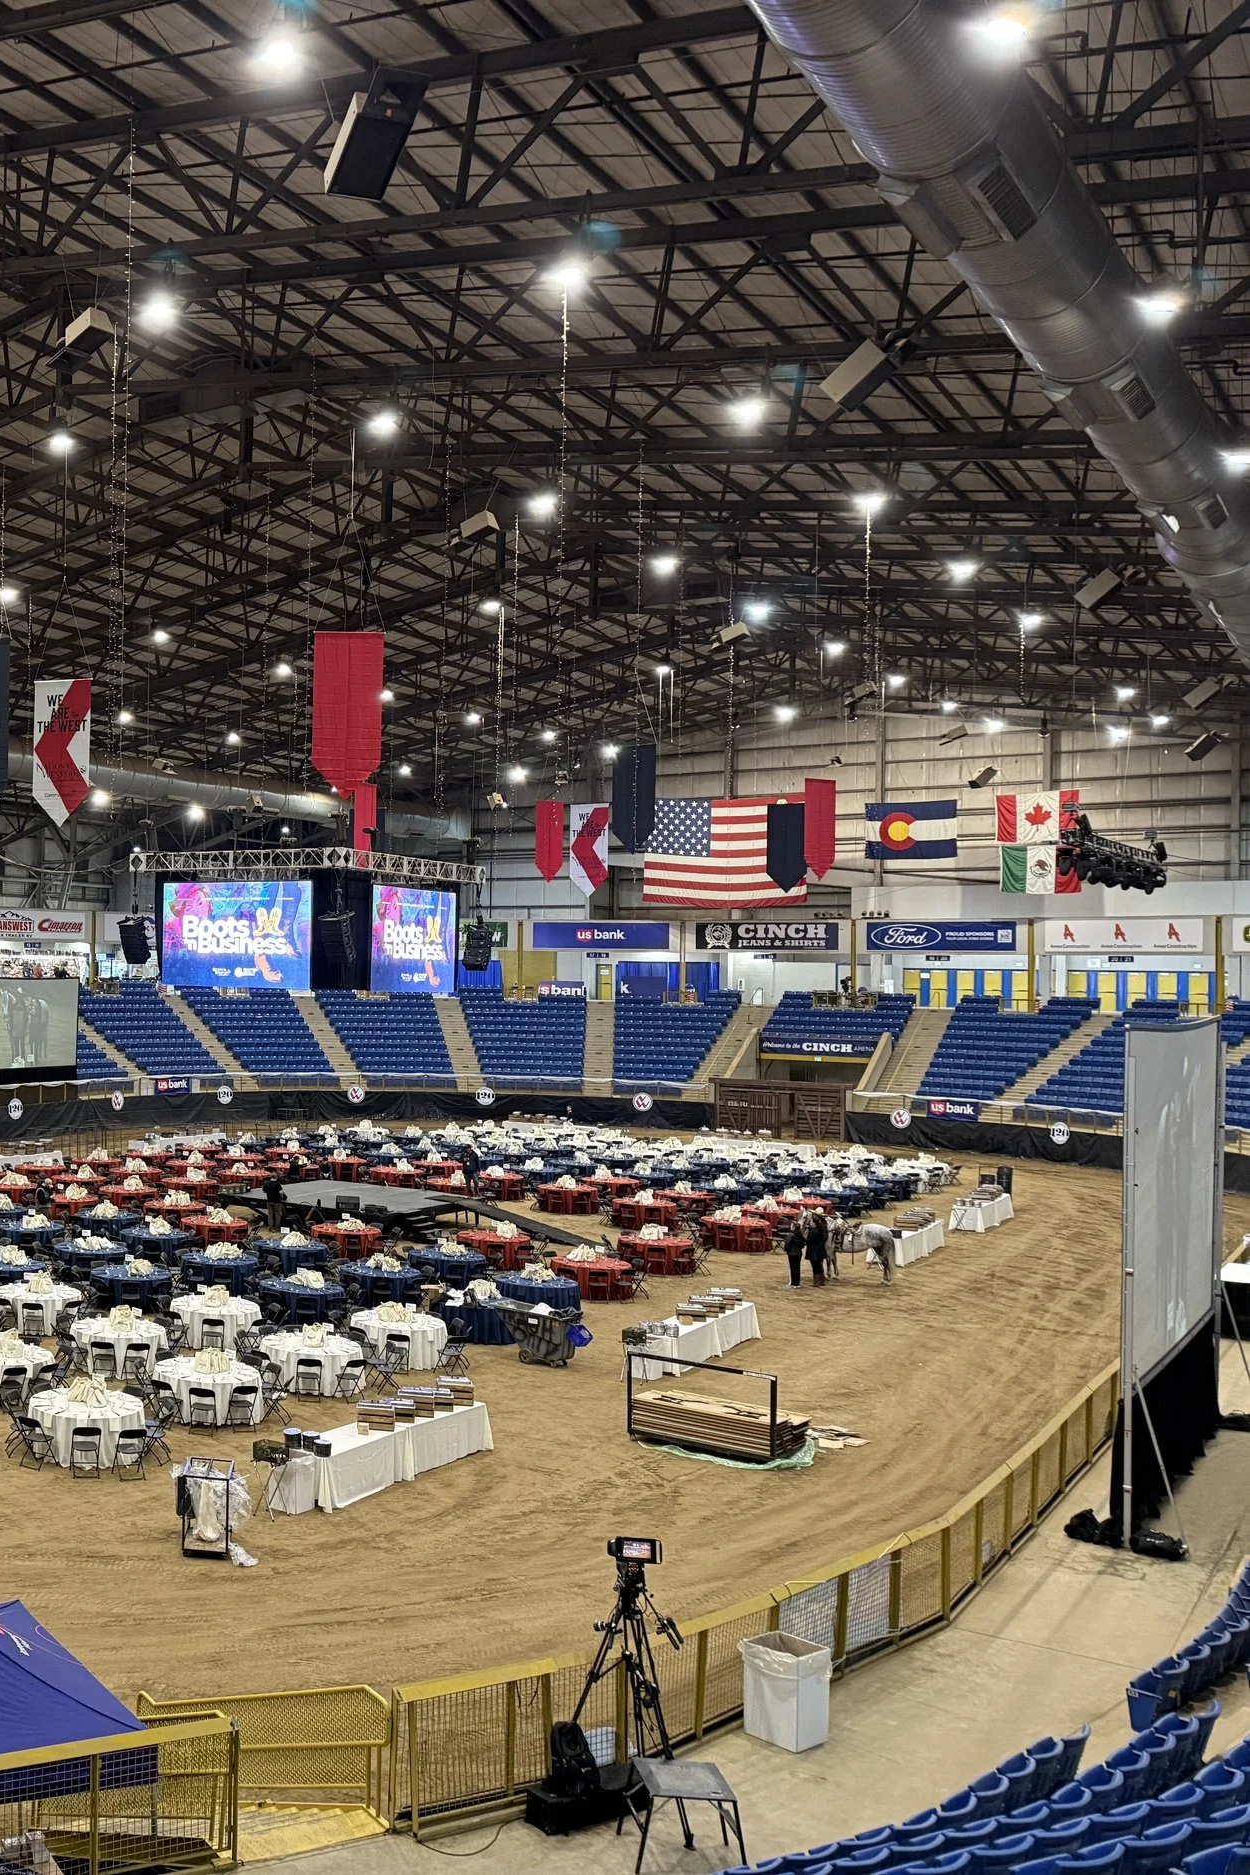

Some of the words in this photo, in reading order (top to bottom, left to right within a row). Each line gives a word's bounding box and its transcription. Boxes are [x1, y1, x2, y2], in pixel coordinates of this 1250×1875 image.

[46, 695, 63, 707] WE
[51, 707, 69, 719] ARE
[37, 721, 56, 733] THE
[58, 719, 87, 732] WEST
[579, 813, 590, 821] WE
[586, 829, 606, 837] WEST
[182, 915, 250, 939] Boots
[383, 919, 424, 944] Boots
[737, 924, 827, 938] CINCH
[577, 931, 592, 939] us
[594, 929, 626, 939] bank
[884, 926, 928, 944] Ford
[197, 936, 287, 955] Business
[393, 941, 444, 961] Business
[802, 1042, 853, 1052] CINCH
[158, 1080, 168, 1089] us
[168, 1078, 188, 1089] bank
[218, 1090, 233, 1099] 120
[477, 1091, 495, 1100] 120
[8, 1104, 23, 1113] 120
[931, 1102, 945, 1112] us
[946, 1102, 975, 1115] bank
[1050, 1128, 1069, 1137] 120
